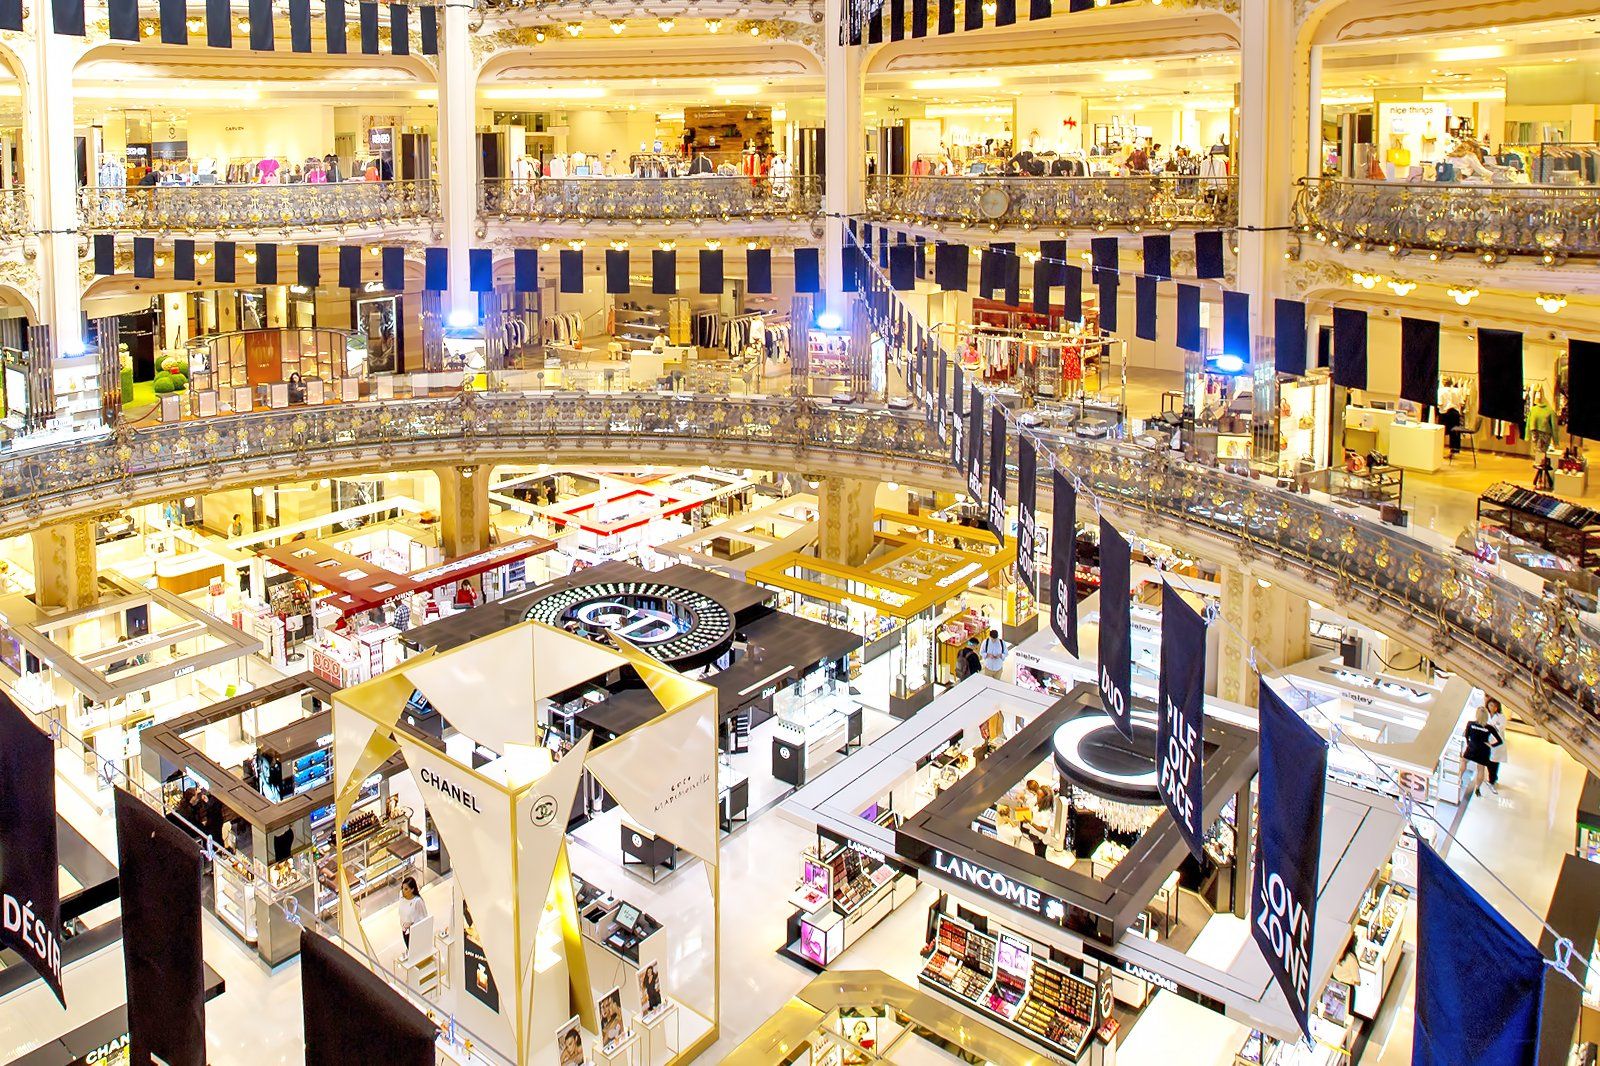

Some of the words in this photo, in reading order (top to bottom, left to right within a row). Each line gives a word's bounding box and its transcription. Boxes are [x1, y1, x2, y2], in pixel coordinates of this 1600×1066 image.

[1101, 664, 1124, 716] DUO
[1167, 693, 1197, 763] PILE
[1169, 735, 1190, 787] OU
[420, 768, 481, 814] CHANEL
[1161, 755, 1194, 834] FACE
[935, 850, 1040, 912] LANCÔME
[3, 893, 62, 987] DÉSIR
[1257, 889, 1308, 1012] ZONE
